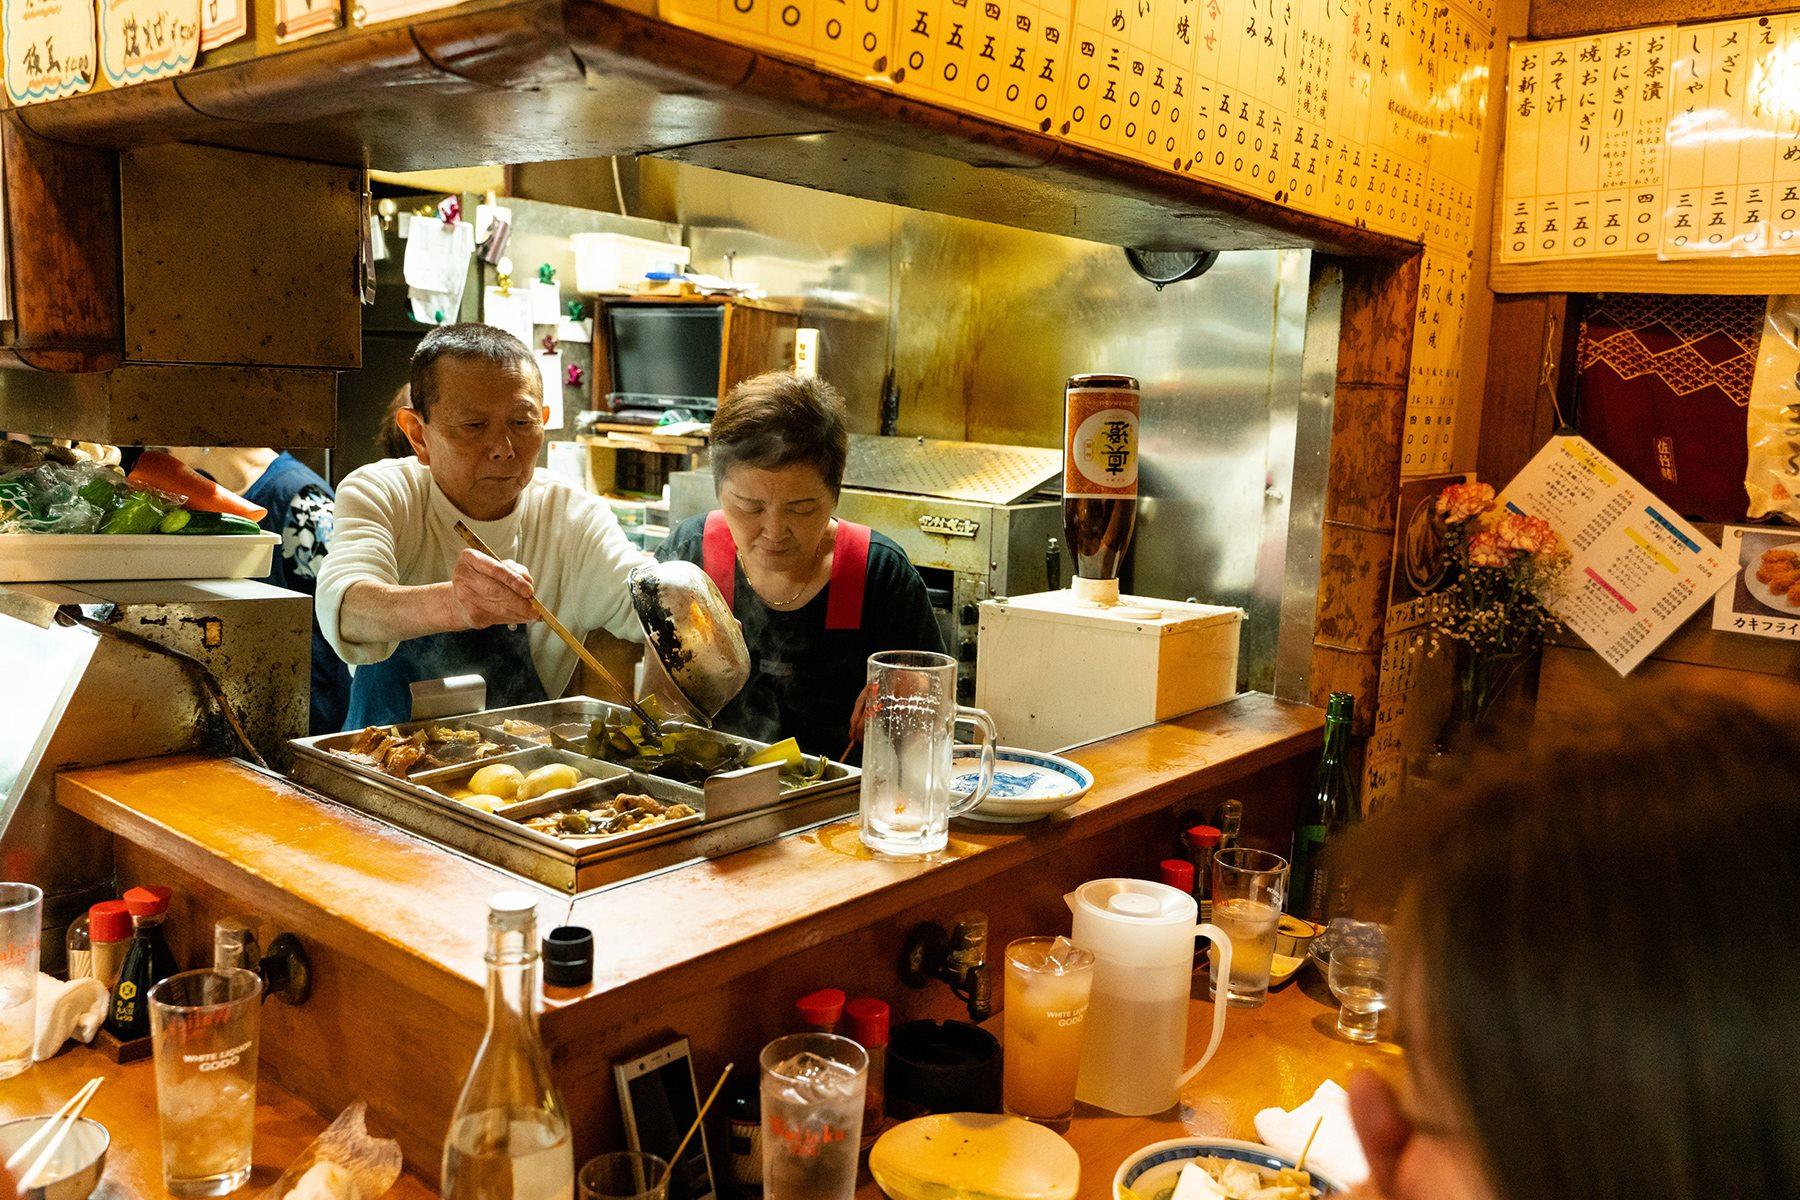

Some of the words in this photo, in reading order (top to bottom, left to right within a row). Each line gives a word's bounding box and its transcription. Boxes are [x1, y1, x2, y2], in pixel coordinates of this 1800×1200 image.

[1545, 51, 1568, 114] みそ汁
[1579, 45, 1602, 153] 焼おにぎり
[1613, 41, 1632, 128] おにぎり
[1734, 617, 1799, 635] カキフライ
